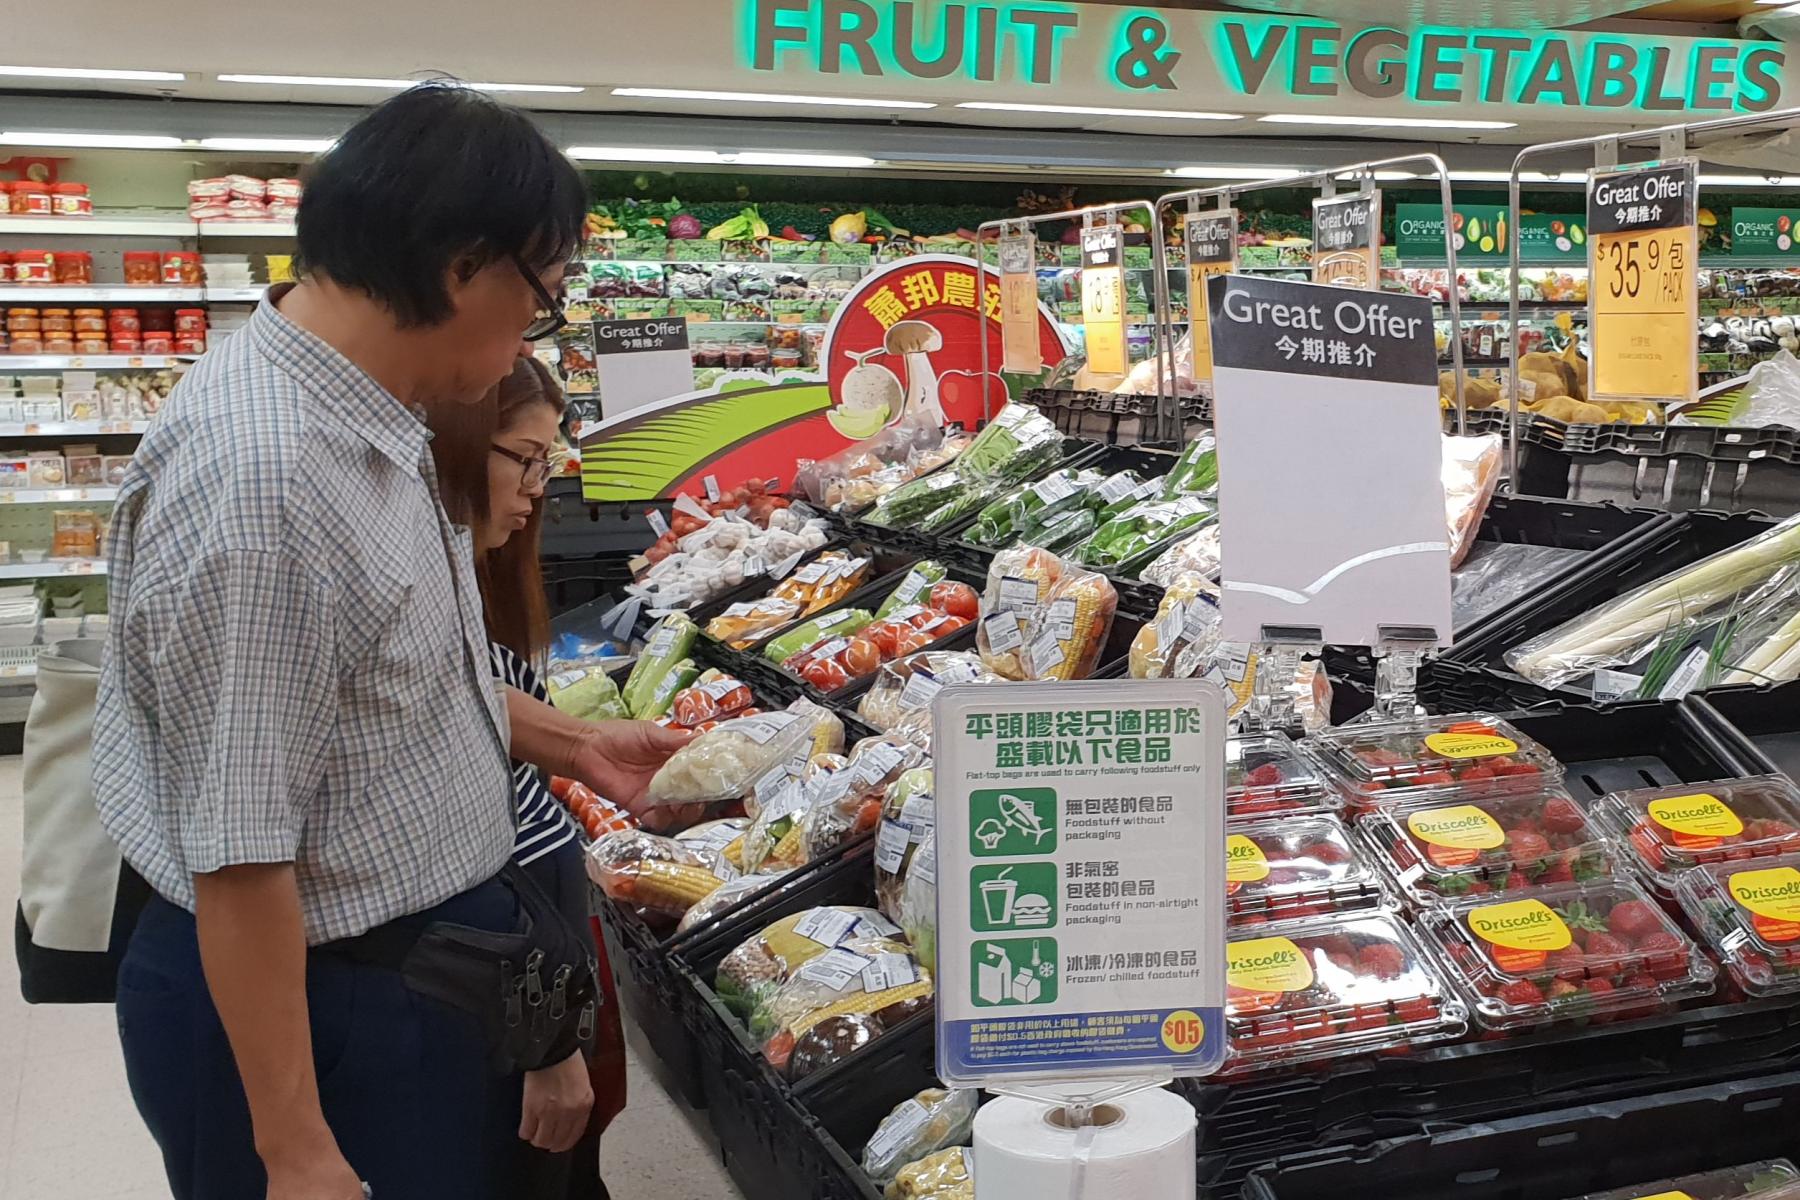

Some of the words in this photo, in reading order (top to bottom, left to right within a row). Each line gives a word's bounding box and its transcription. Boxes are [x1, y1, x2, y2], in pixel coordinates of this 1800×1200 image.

[753, 0, 1078, 84] FRUIT
[1115, 16, 1182, 90] &
[1223, 22, 1786, 112] VEGETABLES
[1596, 183, 1639, 206] Great
[1643, 175, 1685, 201] Offer
[1318, 213, 1342, 230] Great
[1343, 206, 1368, 227] Offer
[1614, 204, 1662, 224] 今期推介
[1735, 222, 1774, 236] ORGANIC
[1223, 289, 1324, 332] Great
[1334, 301, 1422, 340] Offer
[600, 325, 642, 339] Great
[644, 322, 683, 336] Offer
[1275, 335, 1377, 368] 今期推介
[965, 707, 1201, 740] 平頭膠袋只適用於
[996, 737, 1171, 768] 盛載以下食品
[966, 771, 1000, 780] Flat-top
[1002, 771, 1023, 780] bags
[1025, 770, 1040, 778] are
[1041, 769, 1063, 777] used
[1064, 768, 1073, 776] to
[1075, 768, 1098, 777] carry
[1100, 766, 1138, 776] following
[1140, 764, 1181, 774] foodstuff
[1183, 764, 1201, 774] only
[1065, 796, 1173, 816] 無包裝的食品
[1656, 803, 1724, 820] Driscoll's
[1065, 817, 1121, 828] Foodstuff
[1123, 815, 1166, 826] without
[1415, 815, 1489, 833] Driscoll's
[1065, 830, 1121, 841] packaging
[1065, 861, 1119, 878] 非氣密
[1066, 880, 1155, 899] 包裝的食品
[1065, 901, 1121, 912] Foodstuff
[1123, 901, 1133, 910] in
[1136, 898, 1198, 910] non-airtight
[1065, 915, 1121, 926] packaging
[1476, 910, 1552, 931] Driscoll's
[1227, 950, 1297, 969] riscoll's
[1066, 974, 1107, 984] Frozen/
[1109, 971, 1145, 982] chilled
[1147, 969, 1200, 980] foodstuff
[1164, 1019, 1199, 1045] $0.5
